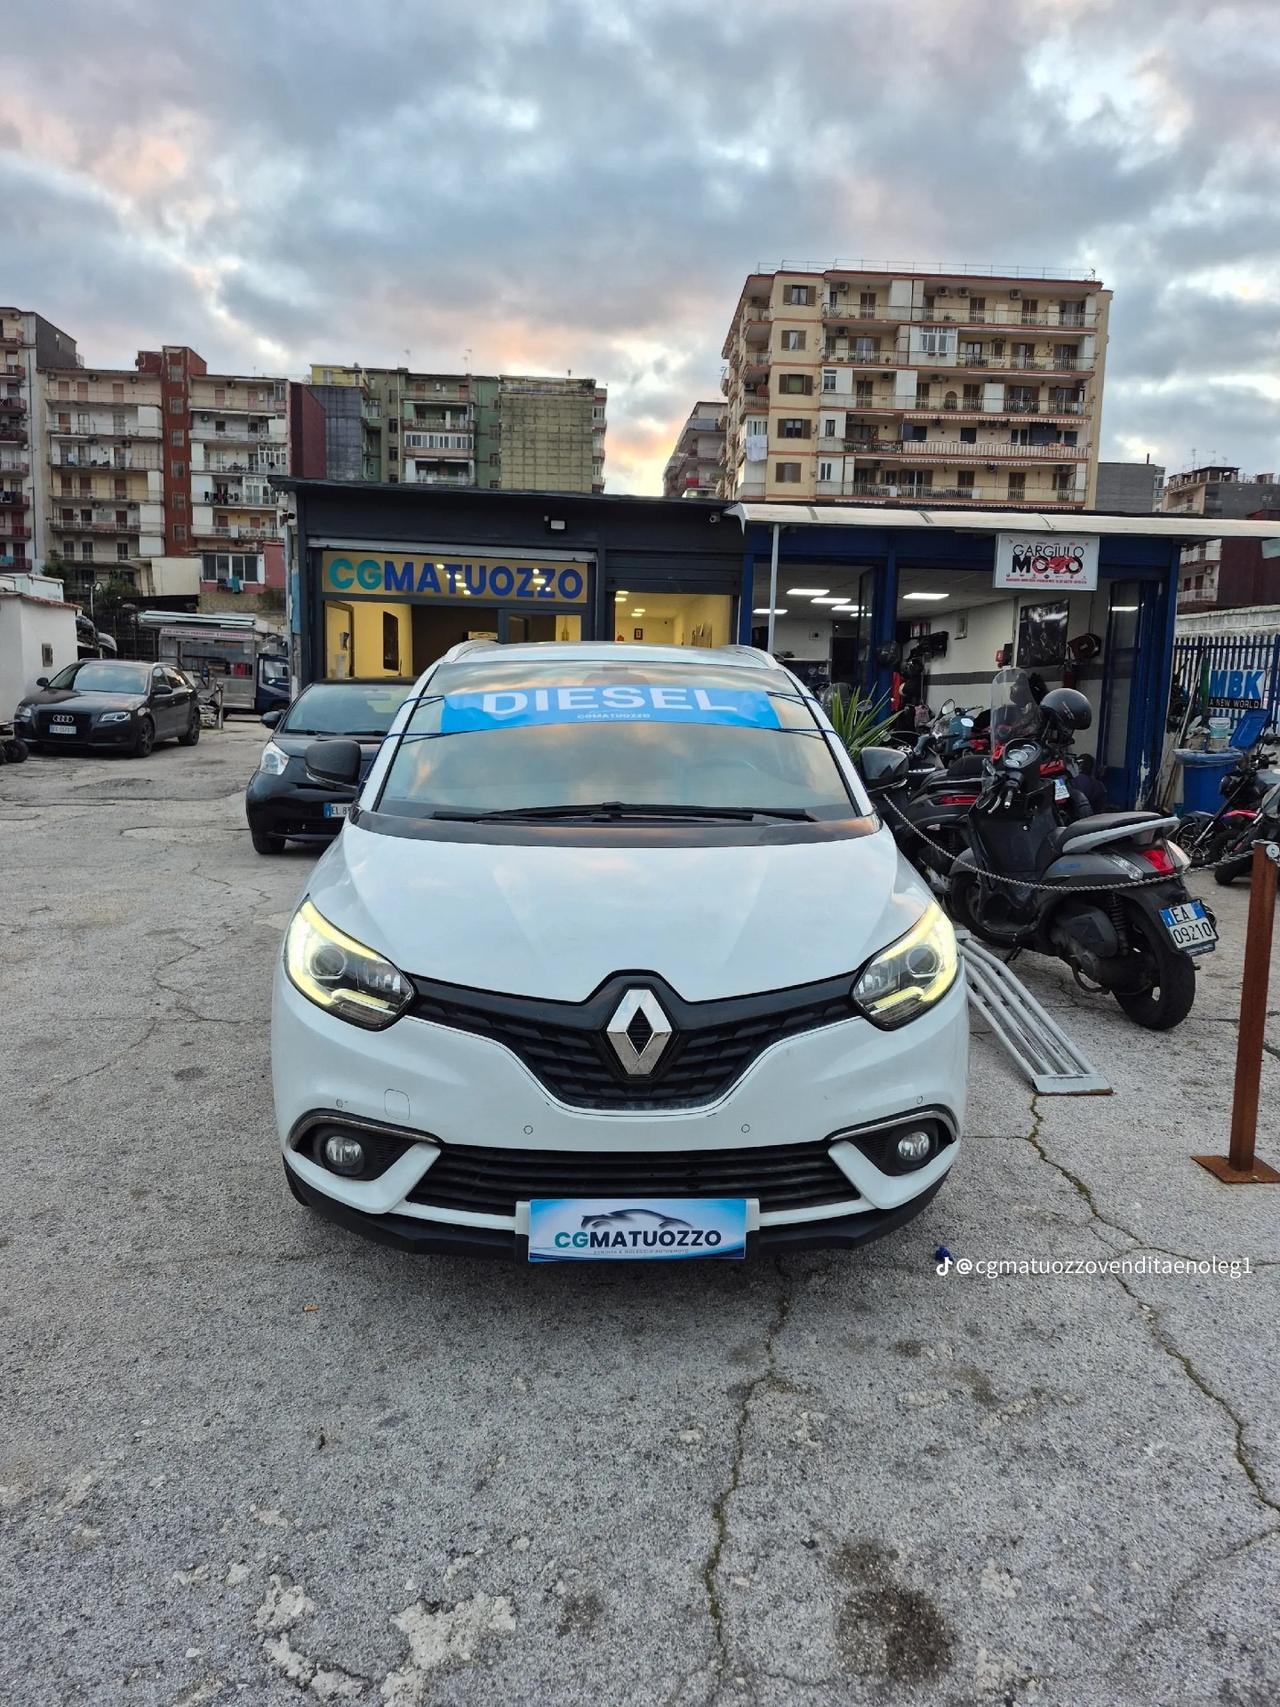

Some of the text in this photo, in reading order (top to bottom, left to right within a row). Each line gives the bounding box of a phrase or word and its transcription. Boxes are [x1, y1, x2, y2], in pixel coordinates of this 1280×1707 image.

[1013, 544, 1085, 558] GARGIULO
[328, 558, 583, 599] CGMATUOZZO
[1208, 671, 1264, 699] MBK
[482, 686, 737, 715] DIESEL
[1216, 699, 1230, 707] NEW
[1234, 700, 1260, 709] WORLD
[1171, 906, 1190, 923] EA
[1172, 922, 1213, 944] 09210
[554, 1230, 722, 1248] CGMATUOZZO
